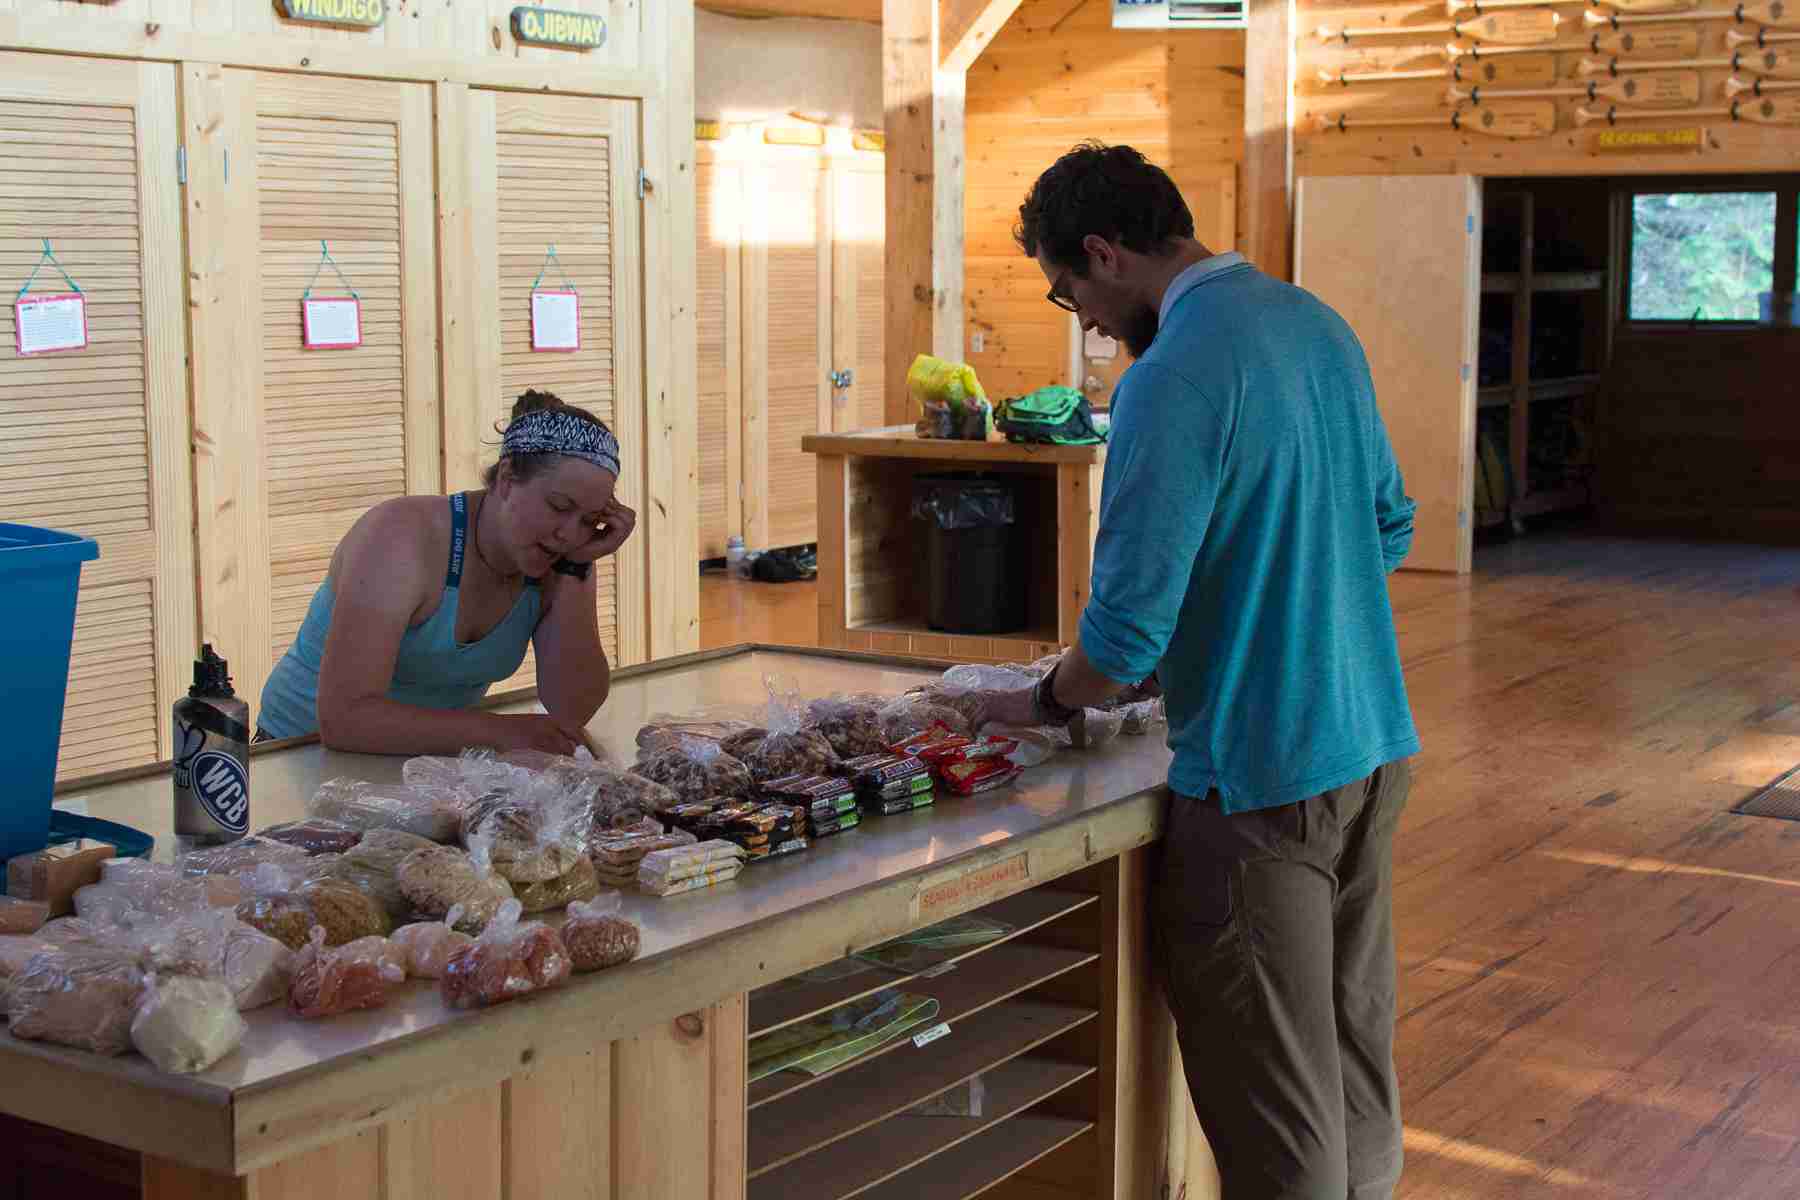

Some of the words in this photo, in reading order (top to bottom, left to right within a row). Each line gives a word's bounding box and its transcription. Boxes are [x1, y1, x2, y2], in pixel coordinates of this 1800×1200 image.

[291, 0, 382, 22] WINDIGO
[523, 10, 603, 44] OJIBWAY
[200, 759, 248, 823] WCB
